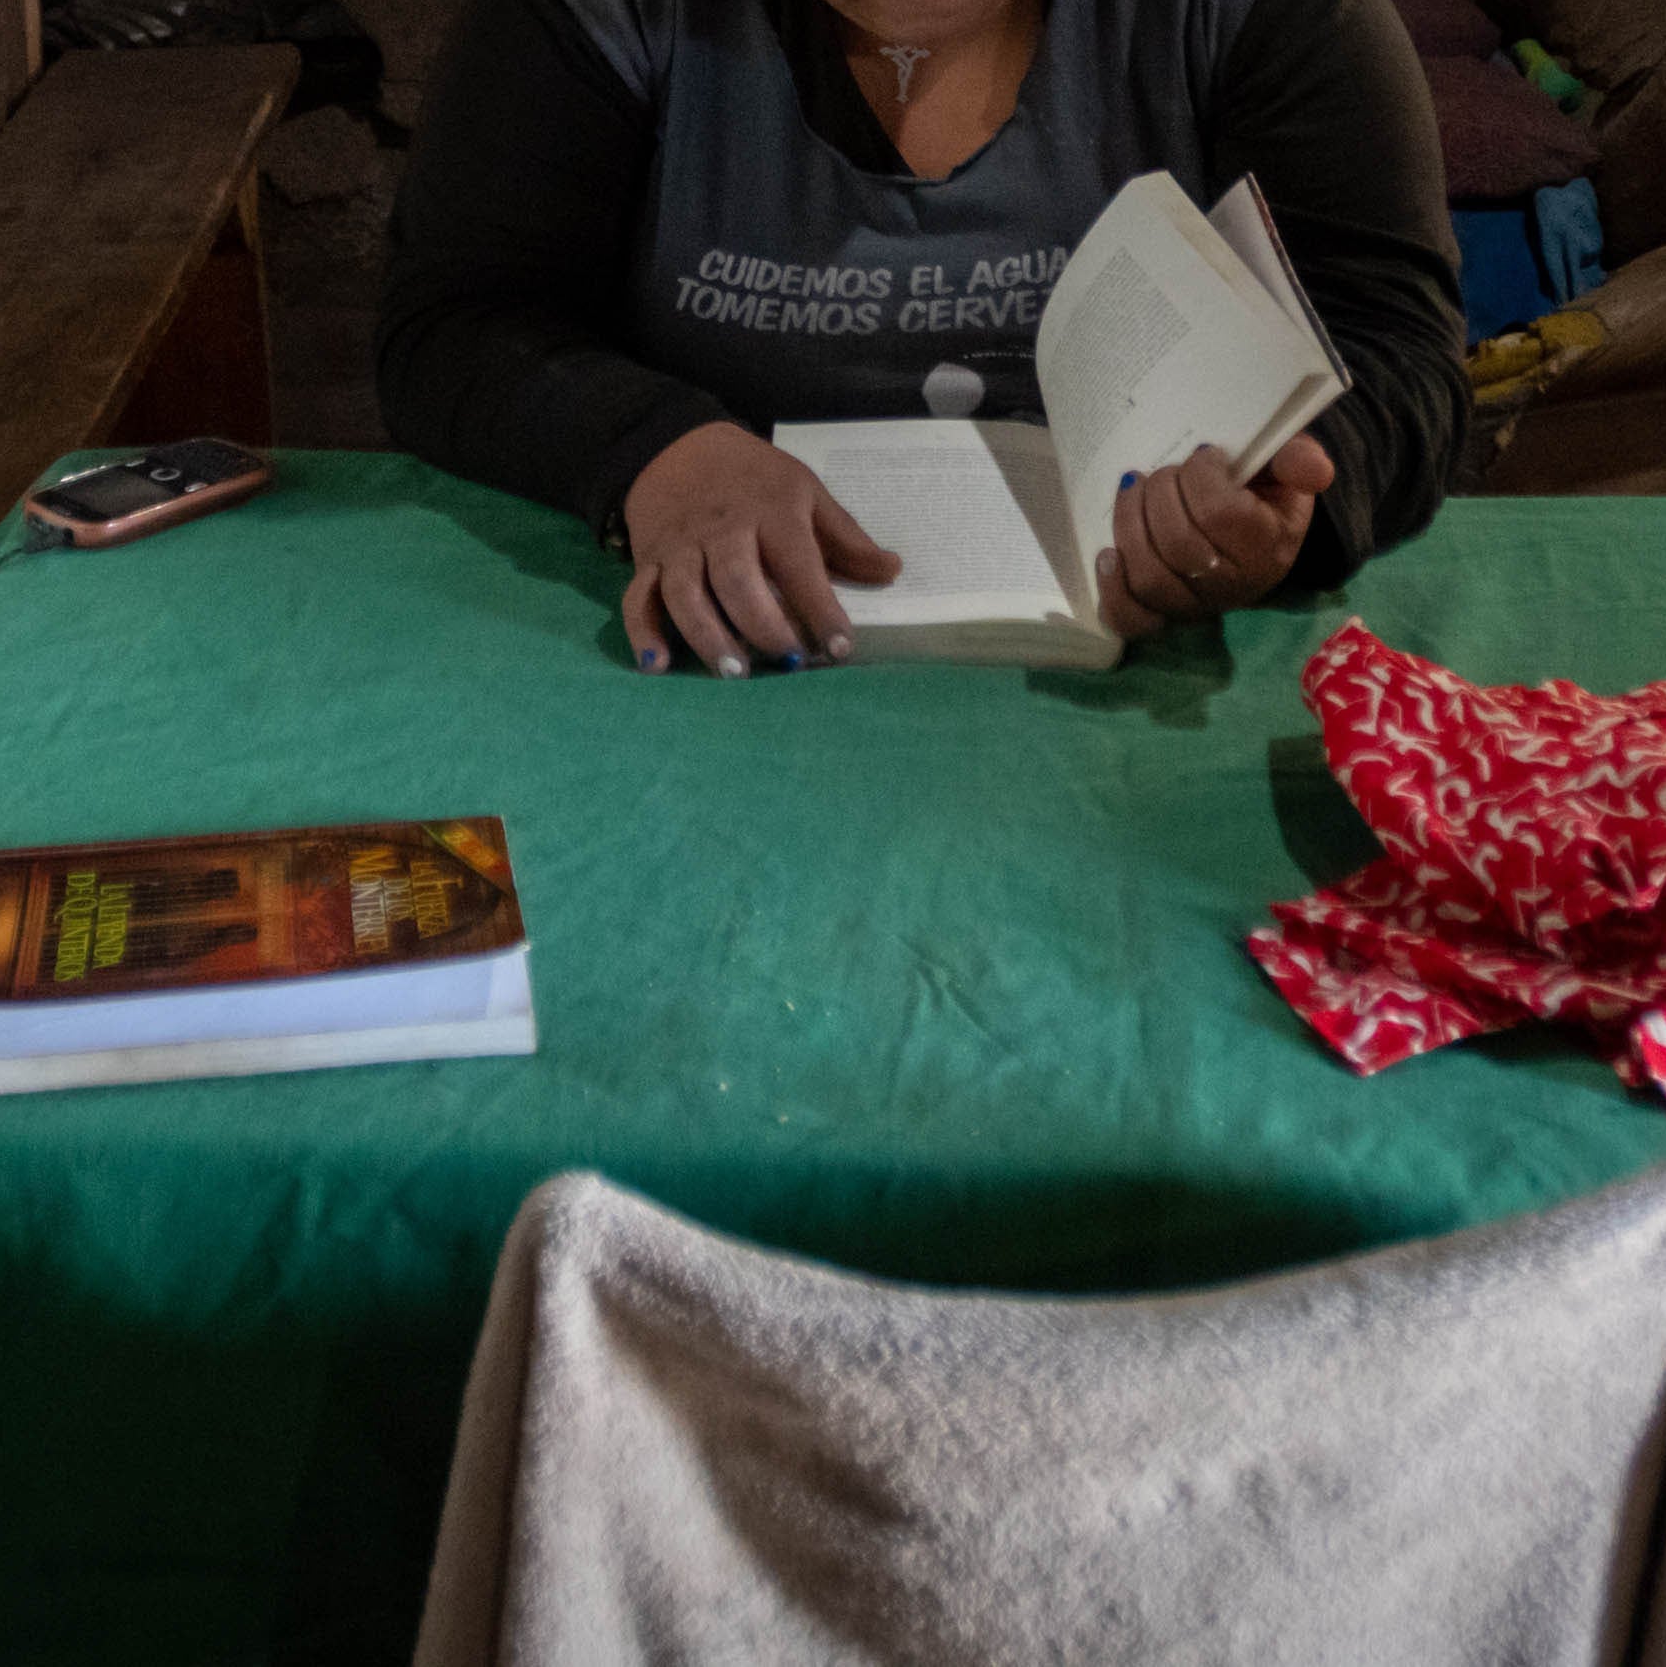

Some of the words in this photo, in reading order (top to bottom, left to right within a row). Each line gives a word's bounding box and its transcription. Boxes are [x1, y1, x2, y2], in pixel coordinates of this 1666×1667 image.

[699, 248, 892, 300] CUIDEMOS
[910, 265, 954, 297] EL
[967, 246, 1074, 295] AGUA
[675, 277, 882, 336] TOMEMOS
[66, 873, 96, 896] DE
[54, 897, 98, 982] QUINTEROS
[92, 904, 132, 970] LEYENDA
